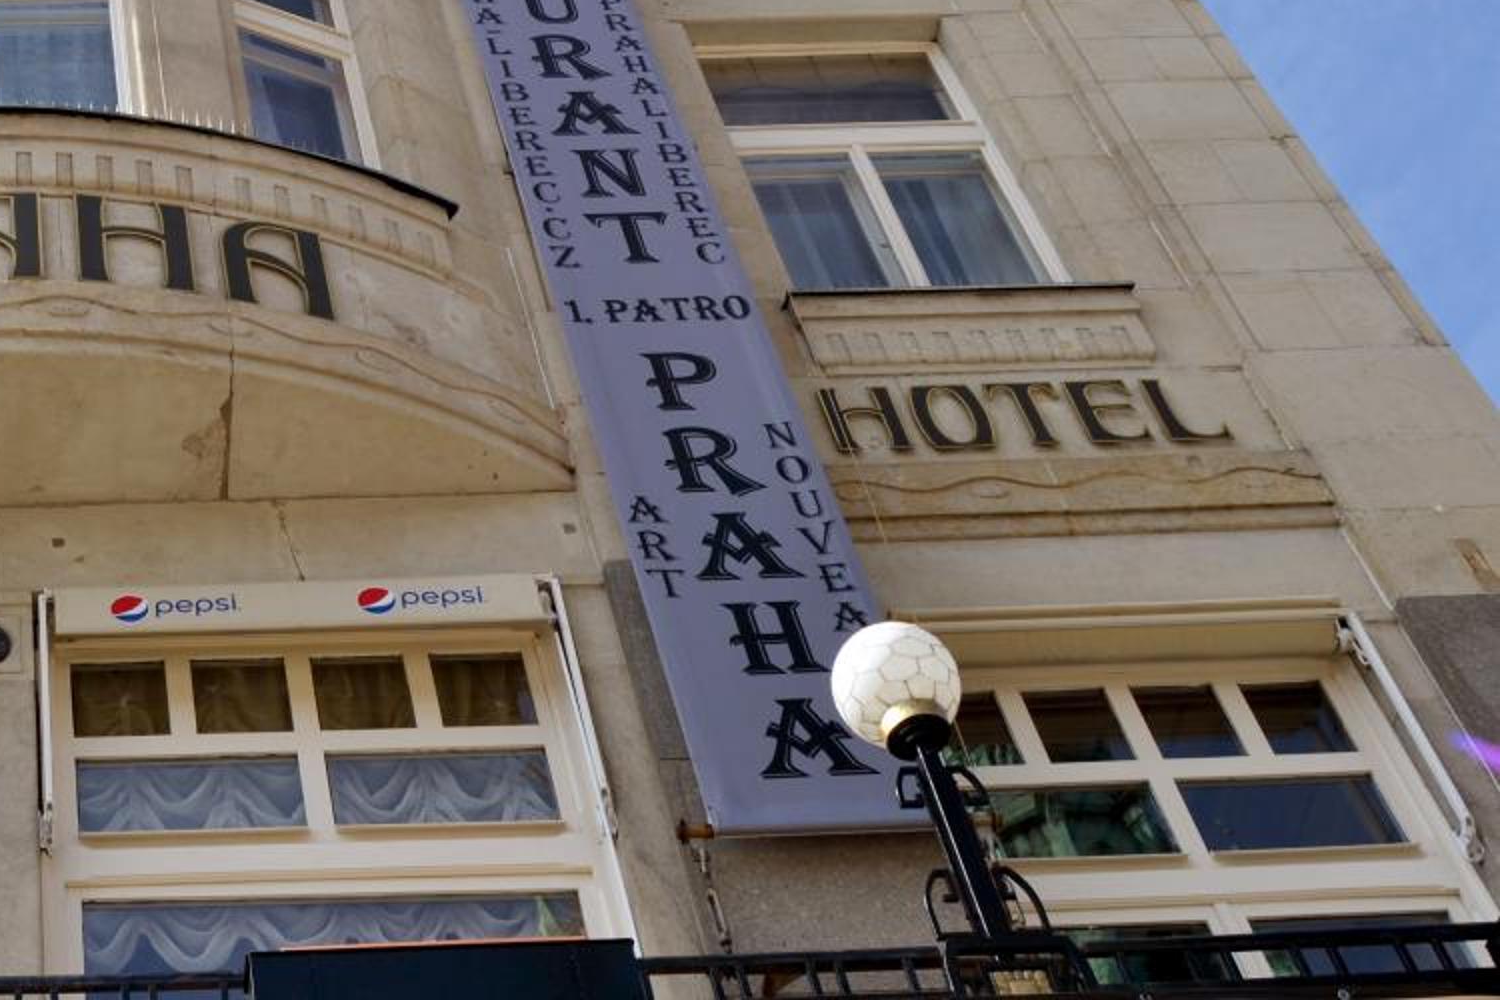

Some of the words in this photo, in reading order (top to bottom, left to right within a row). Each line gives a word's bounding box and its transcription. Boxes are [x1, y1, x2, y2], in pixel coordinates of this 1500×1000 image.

[564, 299, 593, 324] 1.
[604, 295, 752, 323] PATRO
[815, 378, 1236, 456] HOTEL
[628, 496, 686, 599] ART
[640, 351, 882, 780] PRAHA
[762, 421, 870, 634] NOUVEA
[154, 593, 238, 618] pepsi
[400, 586, 484, 610] pepsi
